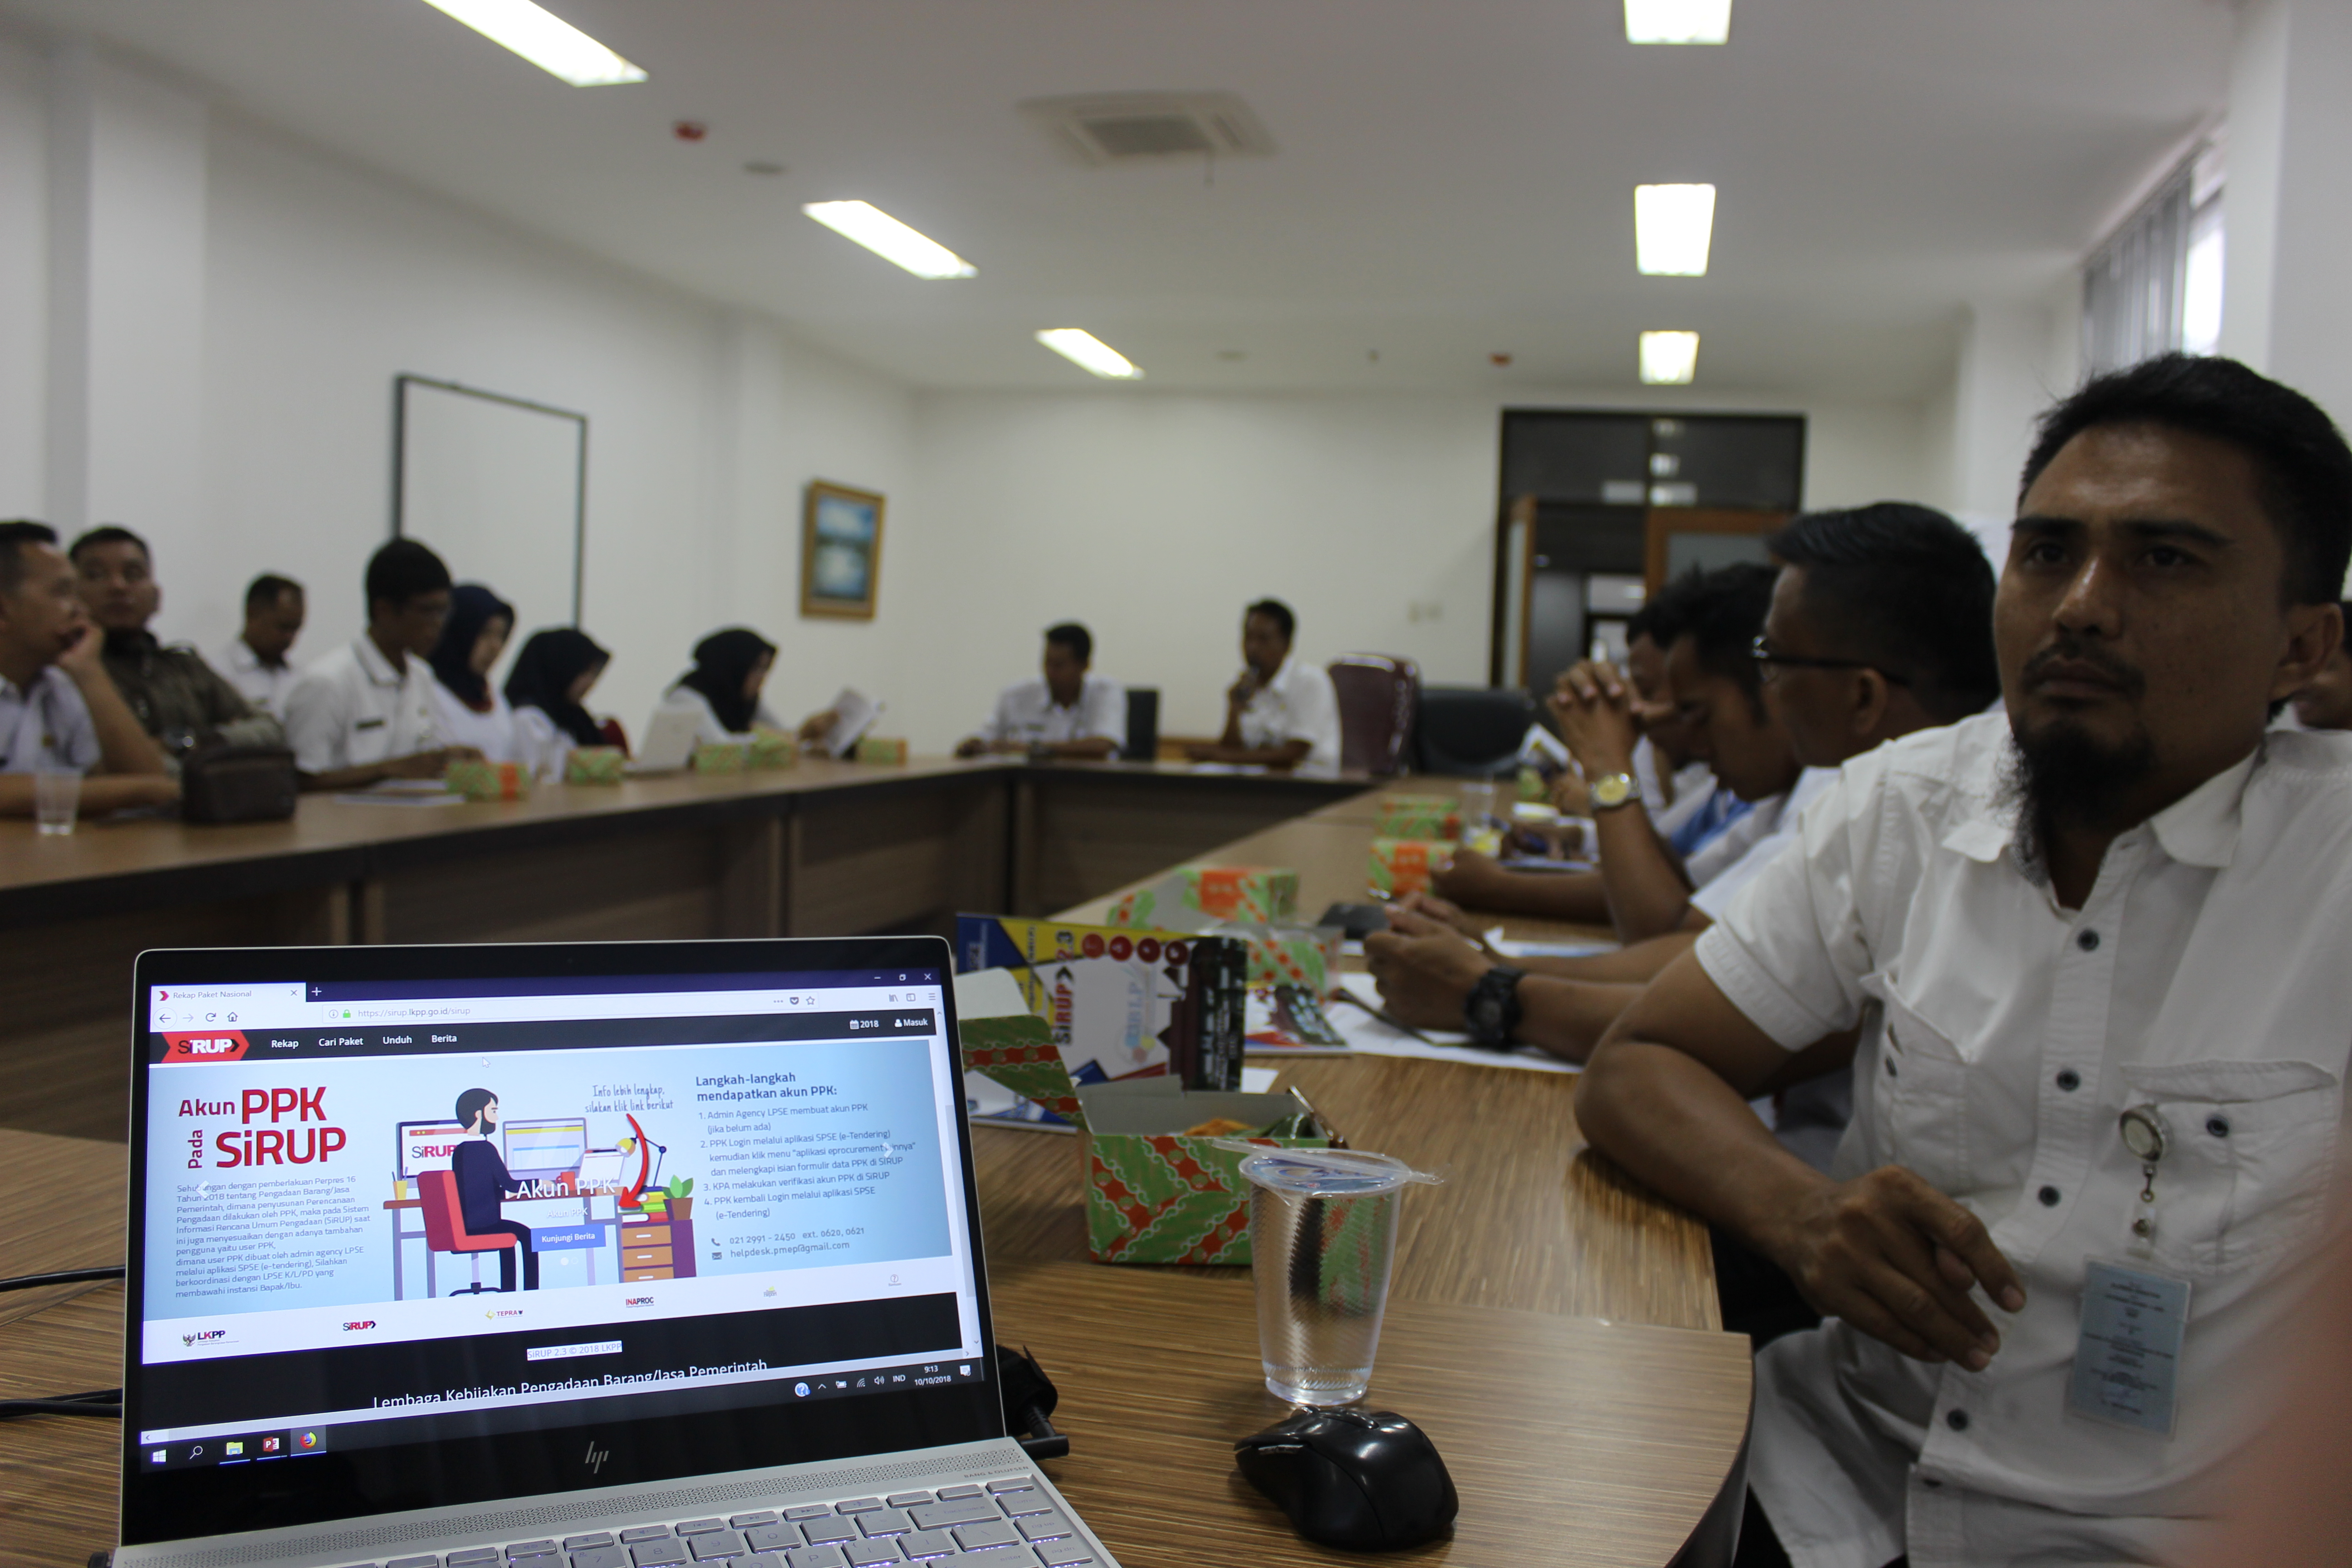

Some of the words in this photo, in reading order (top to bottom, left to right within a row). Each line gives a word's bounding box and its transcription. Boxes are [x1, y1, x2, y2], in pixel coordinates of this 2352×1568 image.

[1056, 930, 1074, 962] 2.3
[358, 1007, 470, 1017] https://sirup.lkpp.go.id/sirup
[904, 1018, 928, 1027] Masuk
[178, 1038, 233, 1054] SiRUP
[271, 1040, 299, 1049] Rekap
[318, 1038, 336, 1046] Cari
[339, 1037, 363, 1045] Paket
[382, 1036, 412, 1044] Unduh
[431, 1034, 457, 1043] Berita
[696, 1072, 796, 1088] Langkah-langkah
[593, 1085, 611, 1097] Info
[613, 1084, 631, 1096] lebih
[634, 1083, 664, 1100] lengkap,
[697, 1089, 777, 1102] mendapatkan
[780, 1088, 808, 1098] akun
[811, 1085, 837, 1096] PPK:
[179, 1099, 235, 1117] Akun
[242, 1087, 328, 1124] PPK
[585, 1101, 611, 1112] silakan
[614, 1100, 628, 1112] klik
[630, 1099, 645, 1111] link
[647, 1098, 673, 1110] berikut
[708, 1111, 734, 1119] Admin
[736, 1110, 765, 1119] Agency
[768, 1108, 788, 1116] LPSE
[790, 1106, 829, 1115] membuat
[708, 1126, 724, 1135] (jika
[754, 1122, 771, 1132] ada)
[710, 1139, 727, 1147] PPK
[729, 1138, 750, 1148] Login
[754, 1137, 782, 1145] melalui
[784, 1135, 814, 1144] aplikasi
[817, 1133, 837, 1142] SPSE
[839, 1130, 890, 1141] (e-Tendering)
[188, 1129, 203, 1168] Pada
[216, 1127, 346, 1168] SiRUP
[710, 1153, 750, 1161] kemudian
[793, 1148, 826, 1157] "aplikasi
[828, 1145, 883, 1156] eprocurement
[711, 1168, 726, 1176] dan
[728, 1166, 775, 1176] melengkapi
[798, 1162, 829, 1171] formulir
[832, 1161, 849, 1169] data
[228, 1182, 257, 1191] dengan
[259, 1179, 313, 1189] pemberlakuan
[516, 1180, 569, 1199] Akun
[575, 1177, 616, 1195] PPK
[713, 1182, 730, 1191] KPA
[732, 1179, 776, 1190] melakukan
[779, 1177, 815, 1186] verifikasi
[817, 1176, 837, 1184] akun
[866, 1171, 889, 1180] SiRUP
[259, 1189, 301, 1198] Pengadaan
[304, 1187, 349, 1196] Barang/Jasa
[714, 1197, 732, 1205] PPK
[733, 1195, 765, 1204] kembali
[768, 1193, 789, 1203] Login
[792, 1191, 820, 1200] melalui
[823, 1188, 853, 1199] aplikasi
[854, 1187, 876, 1195] SPSE
[177, 1205, 224, 1213] Pemerintah,
[258, 1200, 304, 1210] penyusunan
[716, 1208, 770, 1220] (e-Tendering)
[177, 1215, 220, 1224] Pengadaan
[223, 1212, 260, 1220] dilakukan
[323, 1207, 341, 1215] pada
[280, 1219, 322, 1228] Pengadaan
[324, 1216, 352, 1225] (SiRUP)
[187, 1236, 204, 1245] juga
[206, 1233, 263, 1243] menyesuaikan
[325, 1226, 363, 1235] tambahan
[542, 1234, 573, 1243] Kunjungi
[775, 1233, 795, 1241] 2450
[821, 1229, 843, 1237] 0620,
[176, 1247, 215, 1256] pengguna
[217, 1245, 237, 1254] yaitu
[730, 1242, 850, 1258] helpdesk.pmep@gmail.com
[207, 1266, 236, 1275] aplikasi
[261, 1259, 314, 1269] (e-tendering),
[315, 1258, 347, 1266] Silahkan
[626, 1297, 654, 1305] INAPROC
[343, 1321, 372, 1331] SiRUP
[198, 1330, 226, 1340] LKPP
[528, 1349, 552, 1359] SiRUP
[579, 1345, 599, 1353] 2018
[602, 1343, 622, 1352] LKPP
[521, 1378, 599, 1394] Pengadaan
[690, 1359, 767, 1377] Pemerintah
[924, 1365, 938, 1373] 9:13
[914, 1376, 951, 1386] 10/10/2018
[585, 1441, 609, 1474] hp
